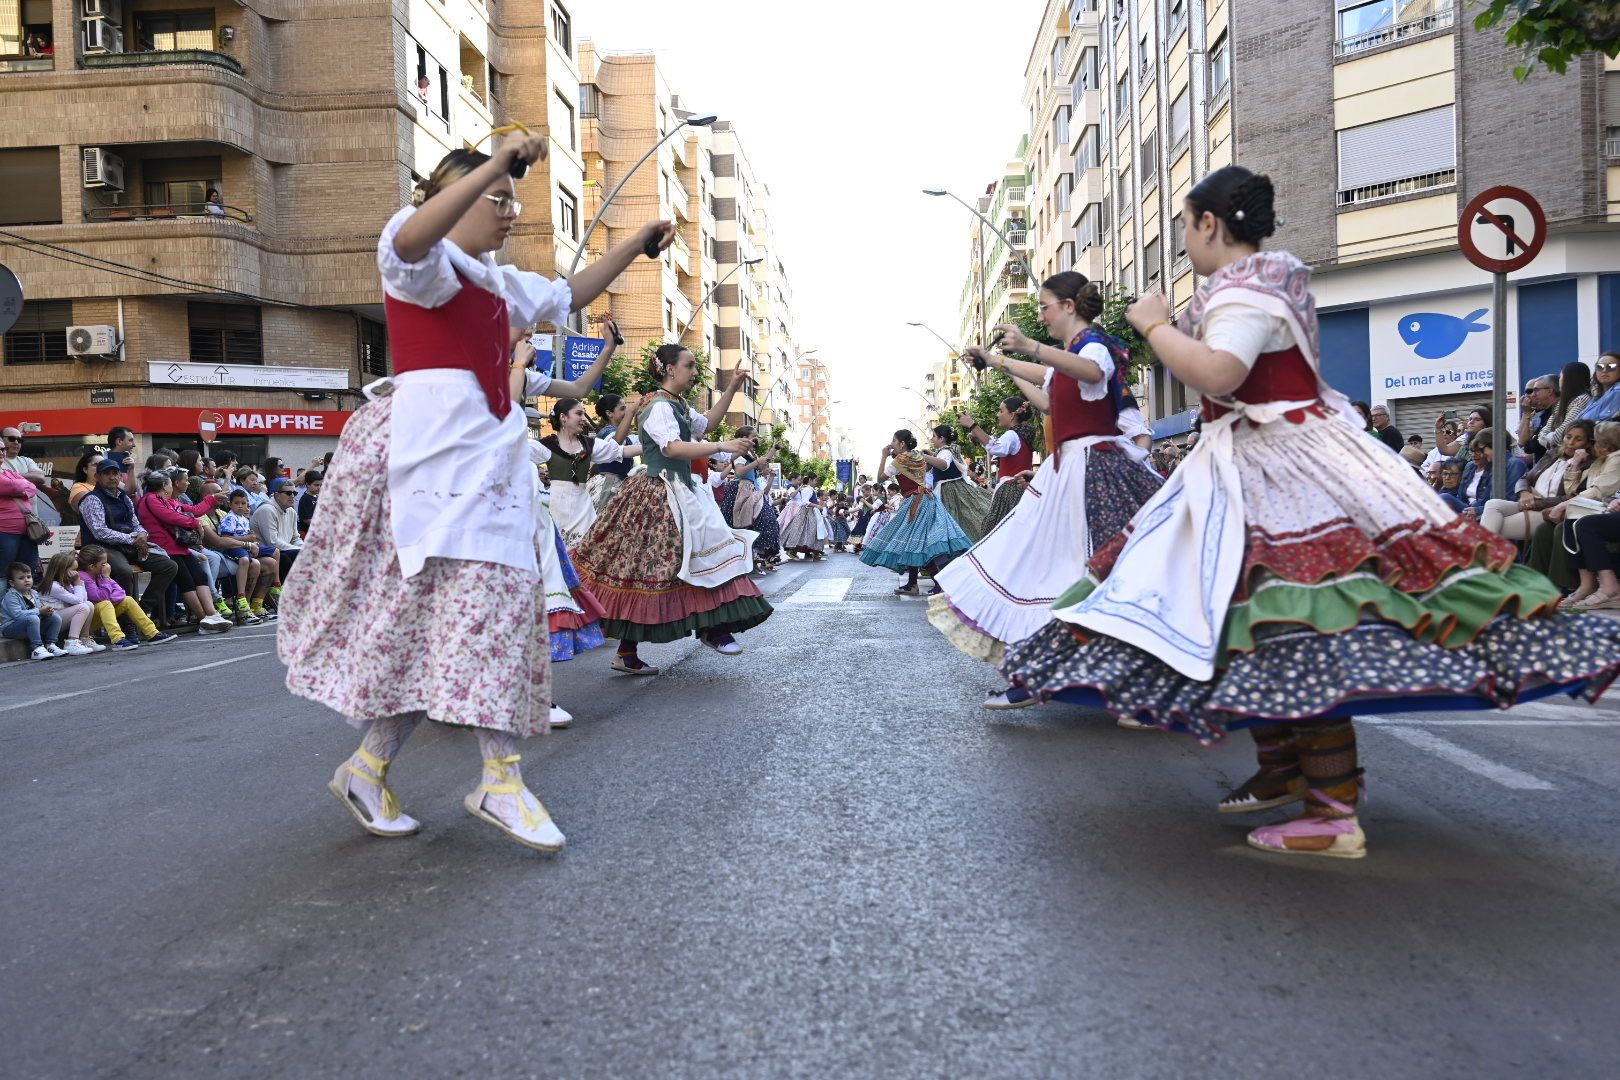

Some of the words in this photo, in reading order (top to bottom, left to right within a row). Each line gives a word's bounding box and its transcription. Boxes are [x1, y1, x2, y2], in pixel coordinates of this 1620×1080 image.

[571, 342, 600, 352] Adrián
[1385, 376, 1405, 388] Del
[1409, 375, 1434, 386] mar
[1438, 374, 1446, 383] a
[1449, 370, 1461, 382] la
[1465, 369, 1494, 381] mes
[228, 413, 324, 430] MAPFRE
